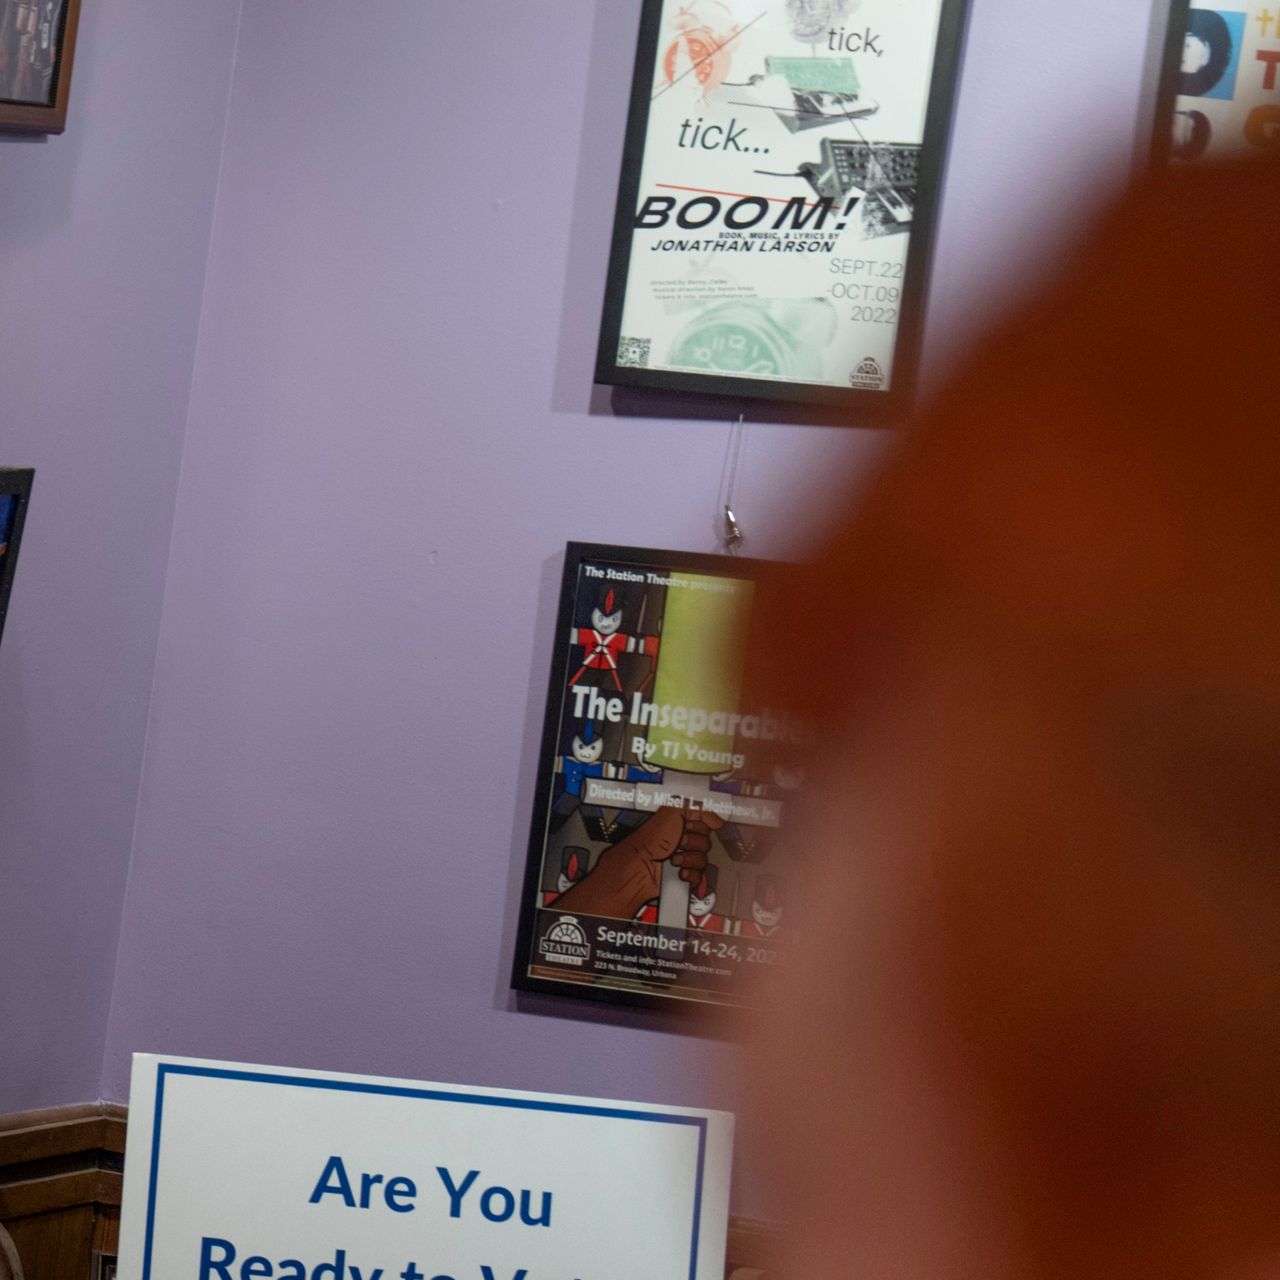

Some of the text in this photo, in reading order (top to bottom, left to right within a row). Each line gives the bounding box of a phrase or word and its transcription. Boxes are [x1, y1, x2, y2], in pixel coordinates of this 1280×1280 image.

[827, 27, 884, 57] tick,
[677, 117, 769, 154] tick...
[634, 196, 860, 230] BOOM!
[650, 239, 836, 253] JONATHAN LARSON
[718, 232, 745, 240] BOOK,
[750, 232, 780, 240] MUSIC,
[829, 258, 904, 279] SEPT.22
[850, 305, 897, 325] 2022
[585, 566, 604, 578] The
[606, 568, 644, 583] Station
[647, 573, 688, 588] Theatre
[571, 684, 624, 722] The
[631, 736, 745, 768] By TJ Young
[590, 784, 635, 803] Directed
[638, 788, 652, 806] by
[542, 941, 588, 956] STATION
[597, 926, 686, 953] September
[690, 939, 741, 963] 14-24,
[595, 950, 621, 961] Tickets
[623, 954, 637, 963] and
[651, 970, 677, 979] Urbana
[308, 1155, 553, 1227] Are You
